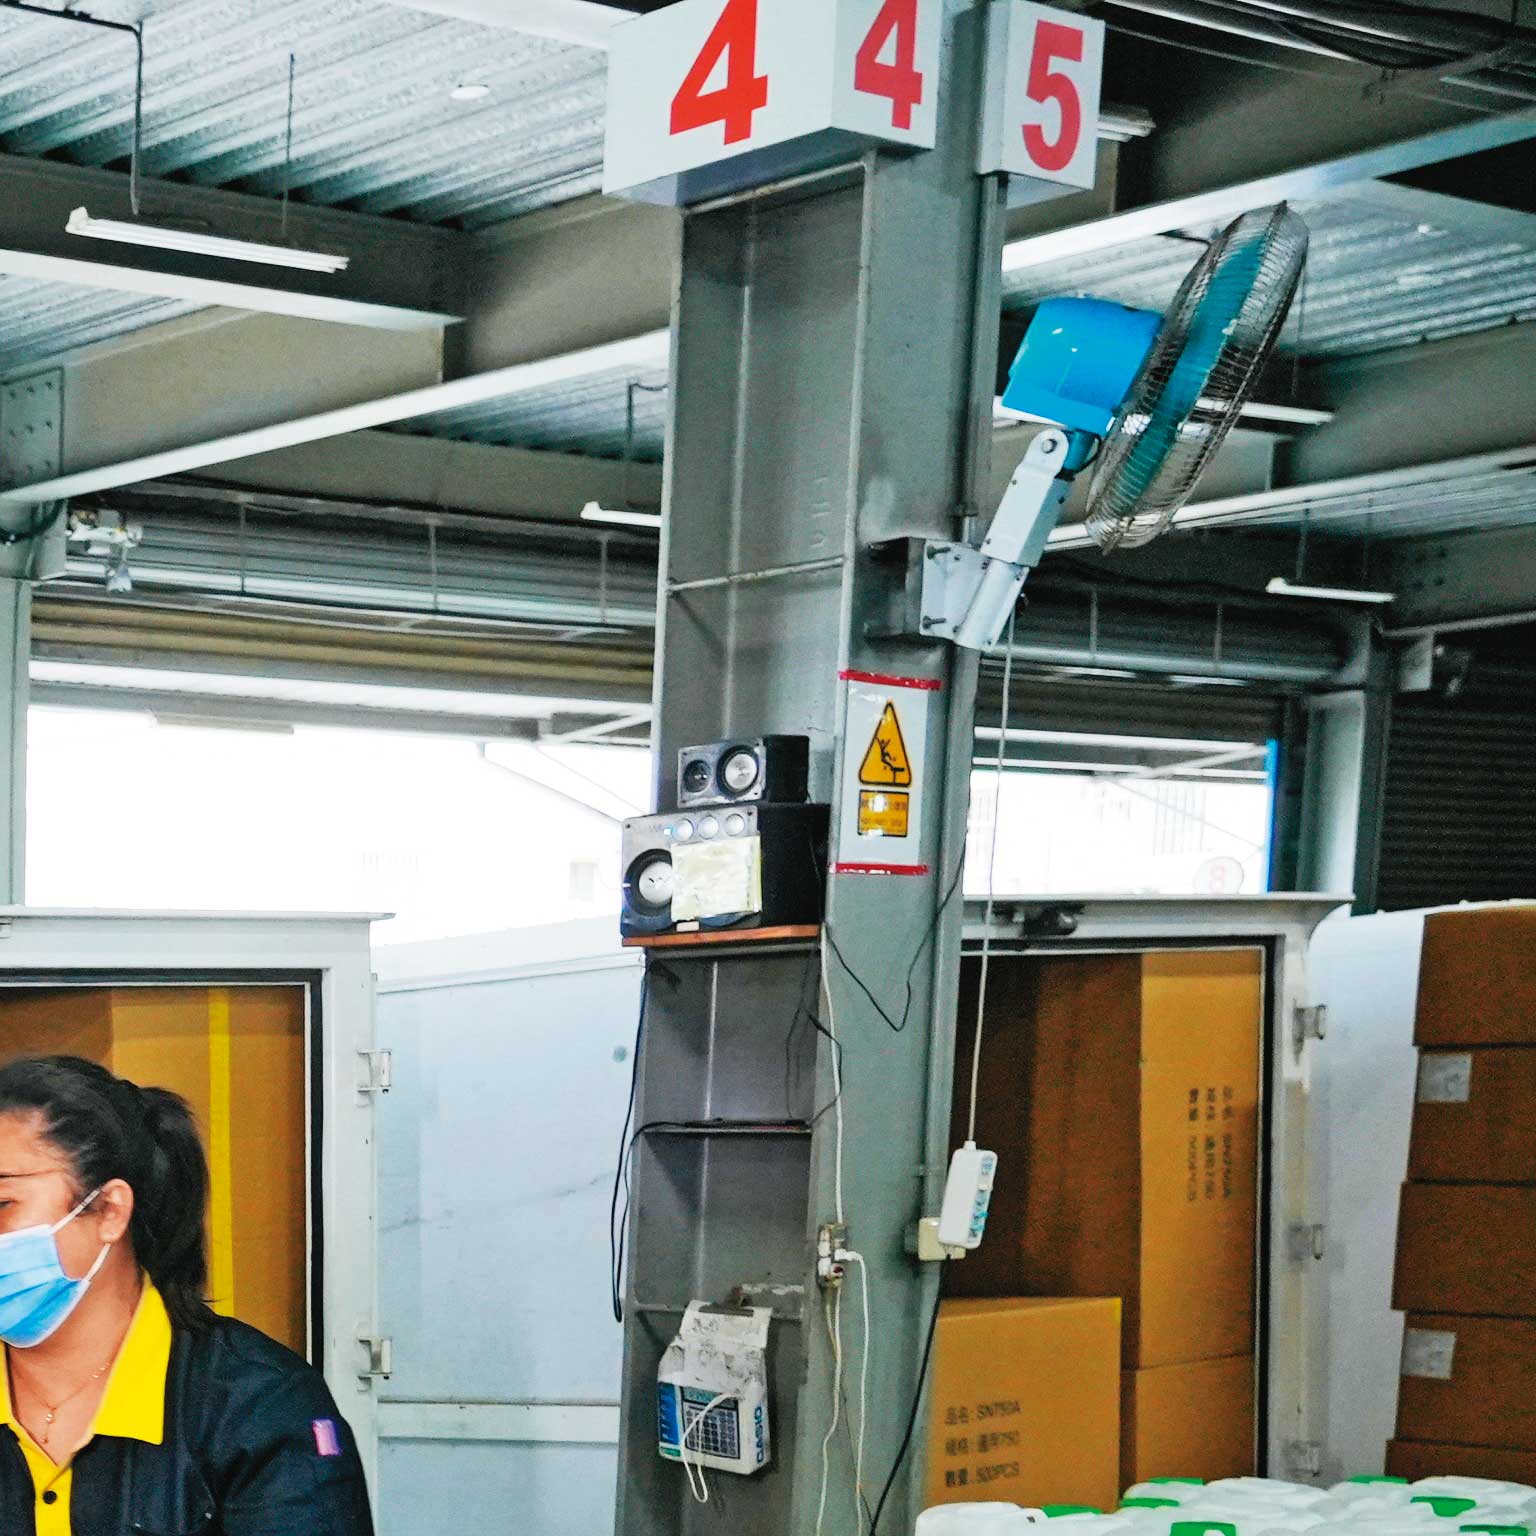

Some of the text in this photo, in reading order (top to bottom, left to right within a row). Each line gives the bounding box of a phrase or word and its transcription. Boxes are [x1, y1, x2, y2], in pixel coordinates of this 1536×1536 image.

[670, 0, 767, 145] 4
[854, 0, 923, 130] 4
[1021, 20, 1084, 171] 5
